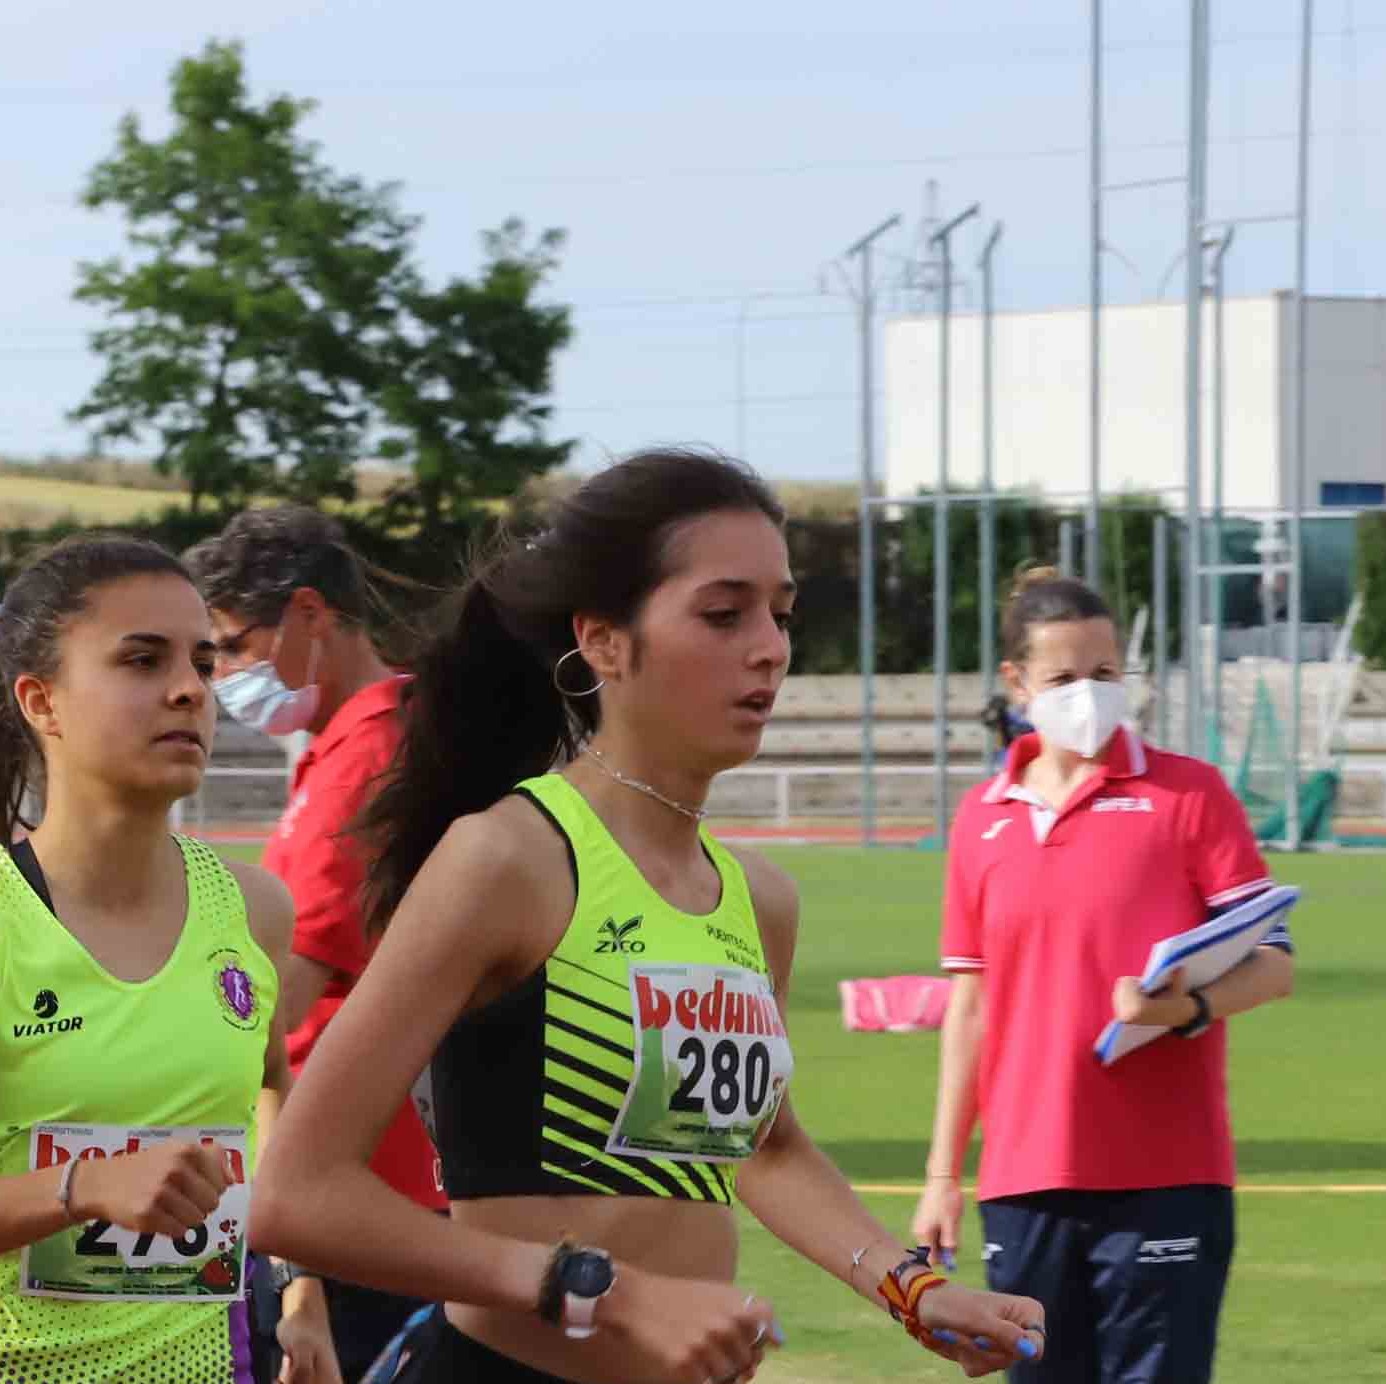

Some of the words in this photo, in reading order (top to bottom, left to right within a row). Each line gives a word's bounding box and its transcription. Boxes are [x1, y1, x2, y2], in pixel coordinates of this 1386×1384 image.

[593, 939, 645, 954] ZICO
[13, 1015, 83, 1039] VIATOR
[669, 1036, 771, 1117] 280
